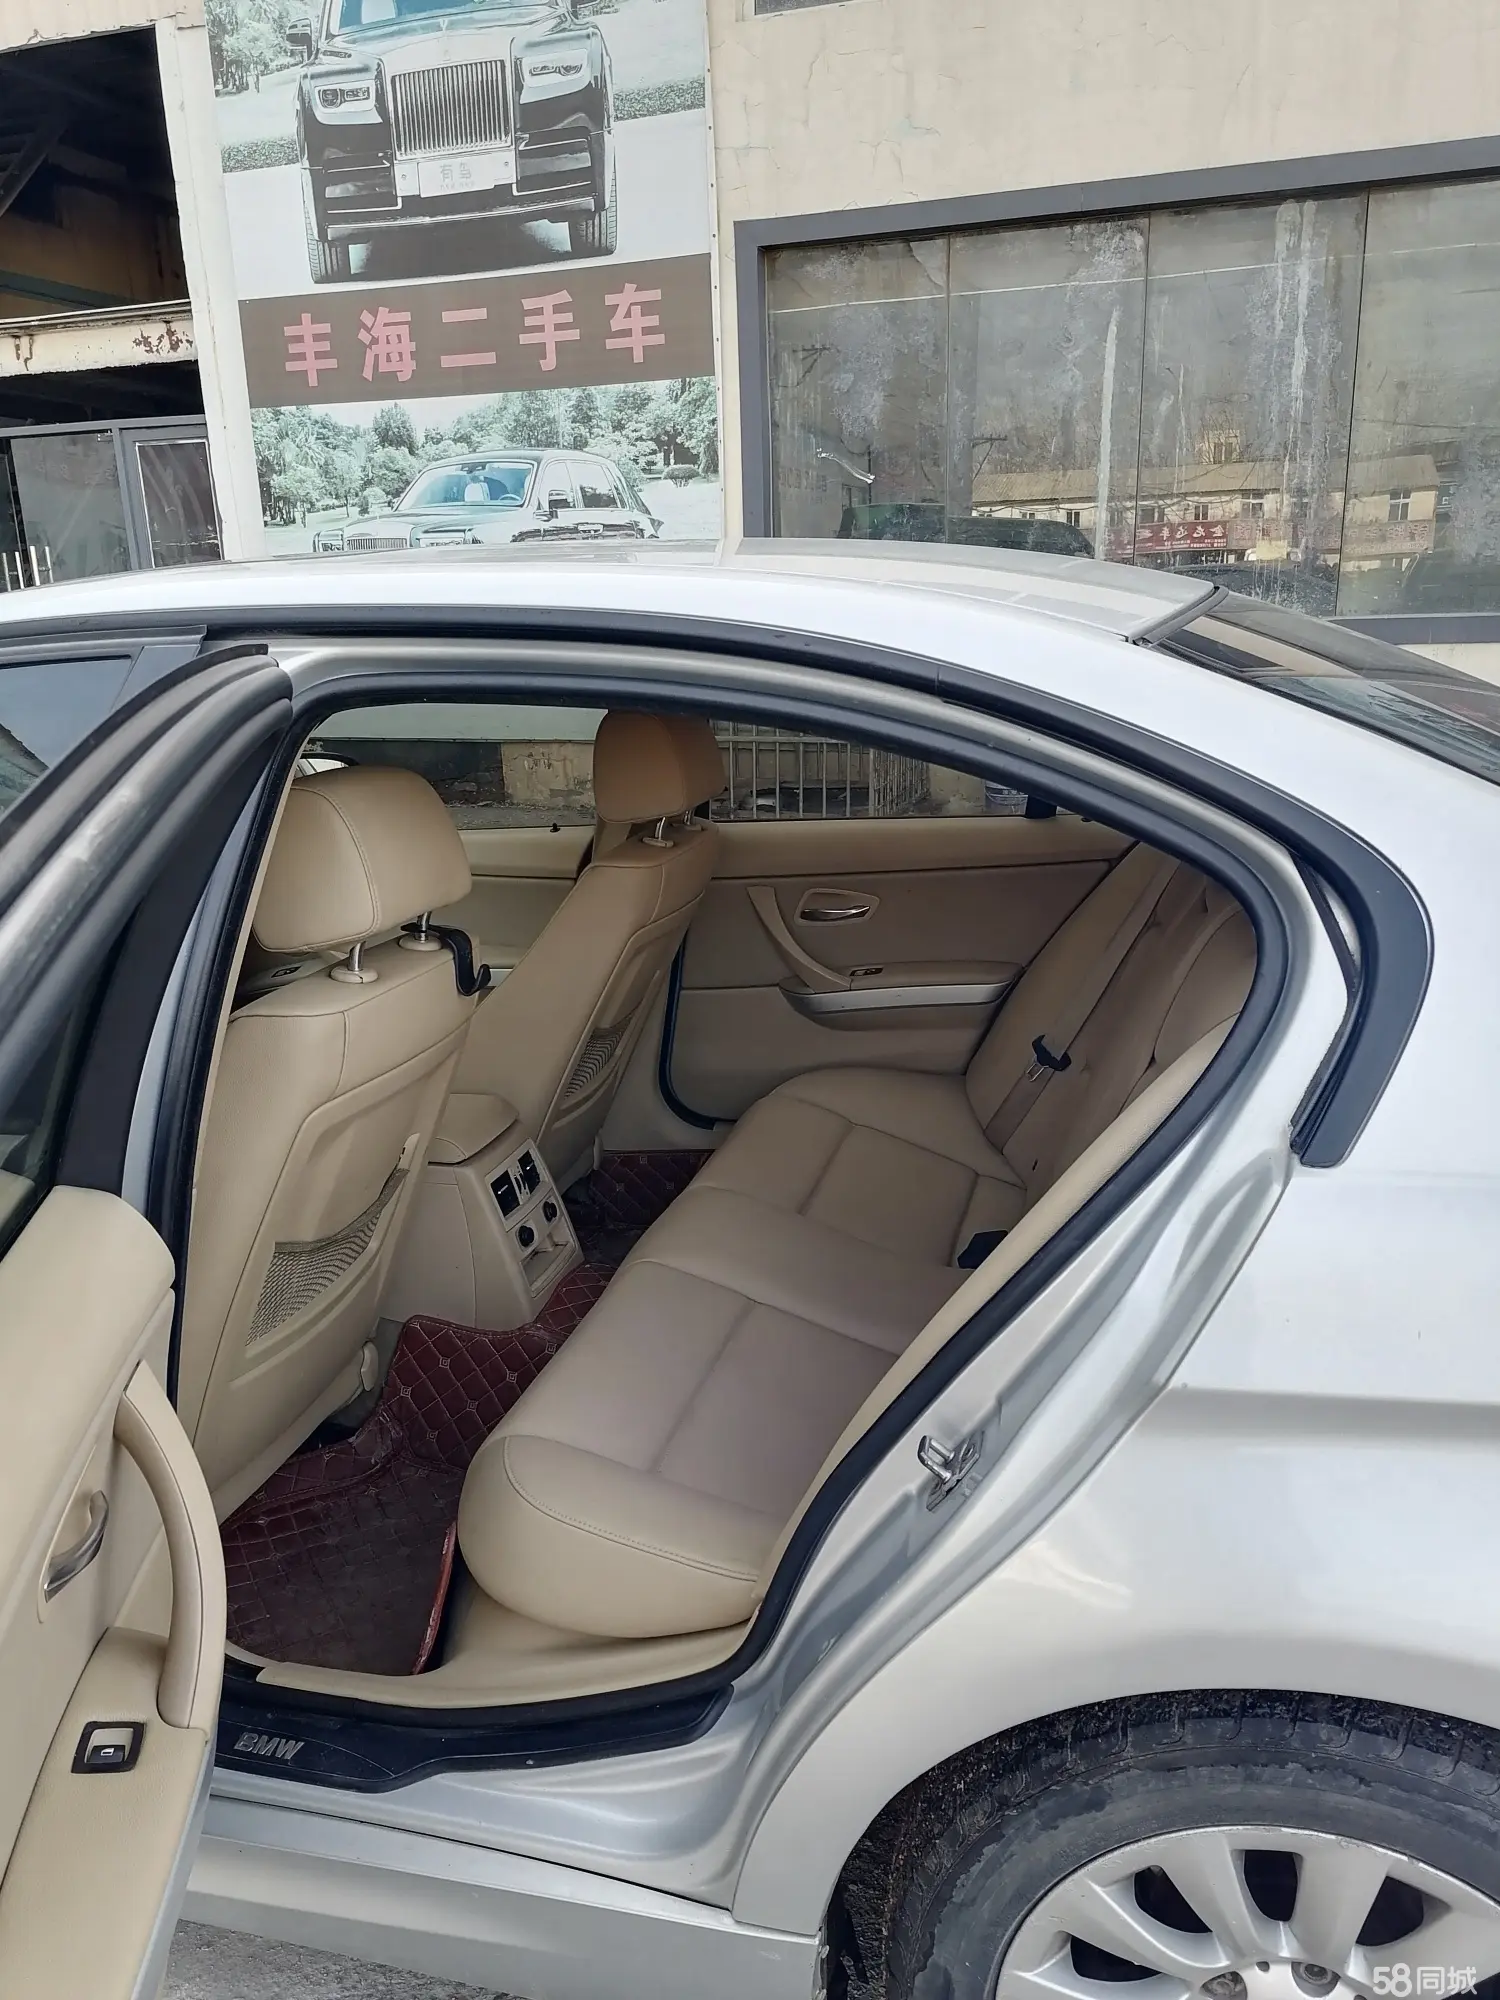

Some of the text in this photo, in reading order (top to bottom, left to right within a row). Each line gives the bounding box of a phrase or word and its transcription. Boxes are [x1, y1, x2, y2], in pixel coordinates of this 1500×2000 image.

[284, 283, 665, 388] 丰海二手车
[233, 1732, 305, 1760] BMW
